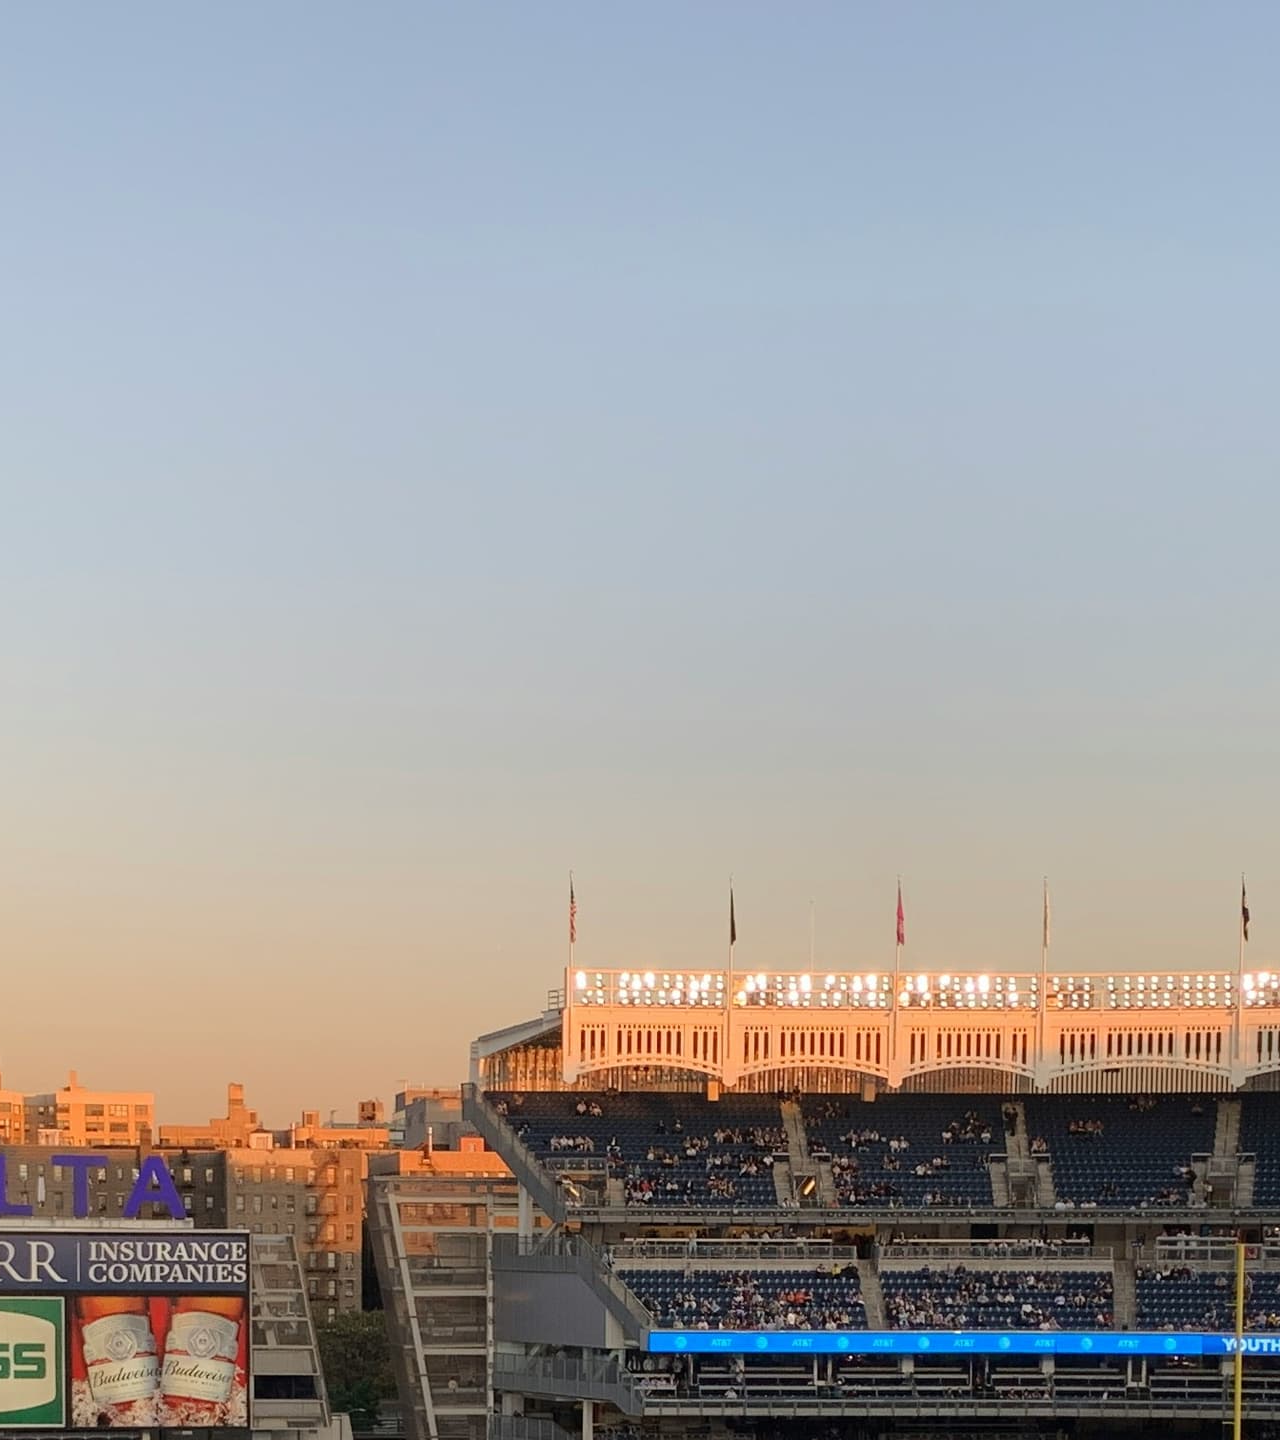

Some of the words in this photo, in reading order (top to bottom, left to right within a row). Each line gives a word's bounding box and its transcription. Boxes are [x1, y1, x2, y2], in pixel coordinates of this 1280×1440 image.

[88, 1241, 247, 1262] INSURANCE
[88, 1263, 247, 1284] COMPANIES
[1222, 1338, 1280, 1353] YOUTH
